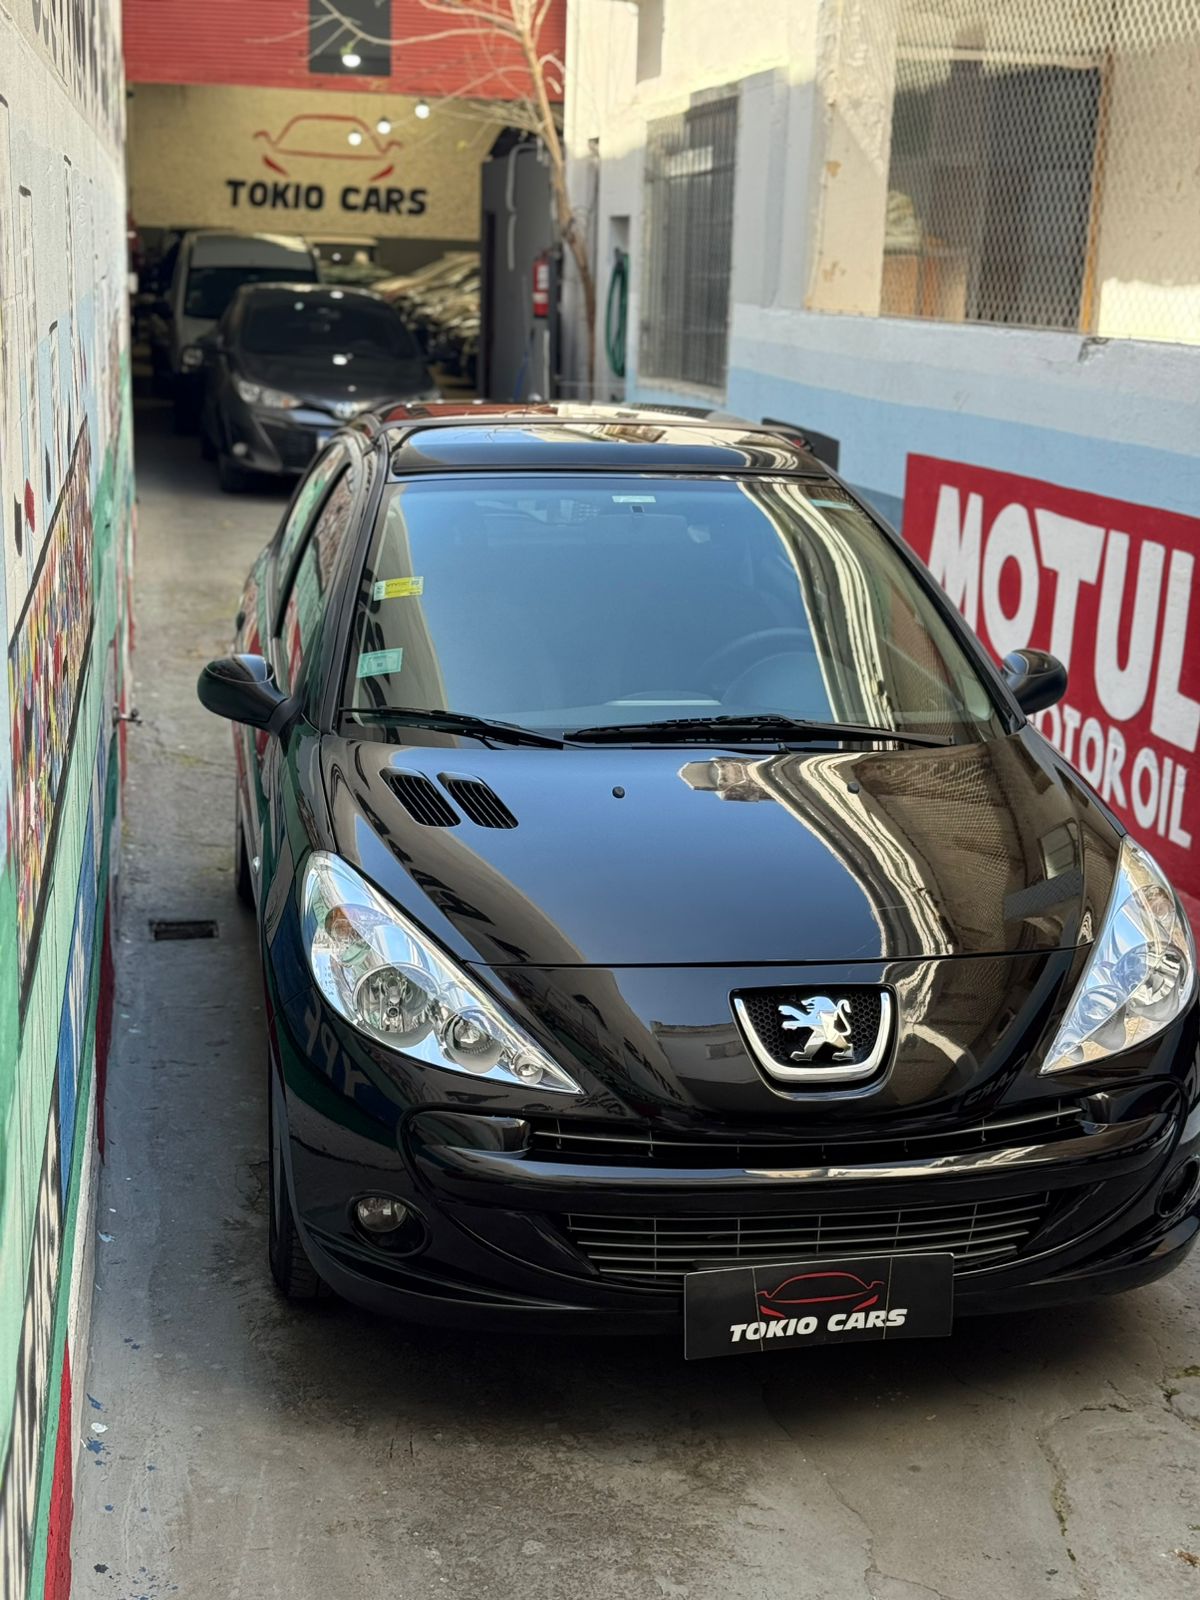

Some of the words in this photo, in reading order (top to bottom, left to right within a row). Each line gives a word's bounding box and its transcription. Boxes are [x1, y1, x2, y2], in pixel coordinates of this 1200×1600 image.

[226, 179, 324, 210] TOKIO
[340, 186, 427, 215] CARS
[928, 484, 1200, 752] MOTUL
[1028, 703, 1127, 808] OTOR
[1131, 747, 1192, 850] OIL
[730, 1316, 818, 1342] TOKIO
[827, 1308, 908, 1332] CARS
